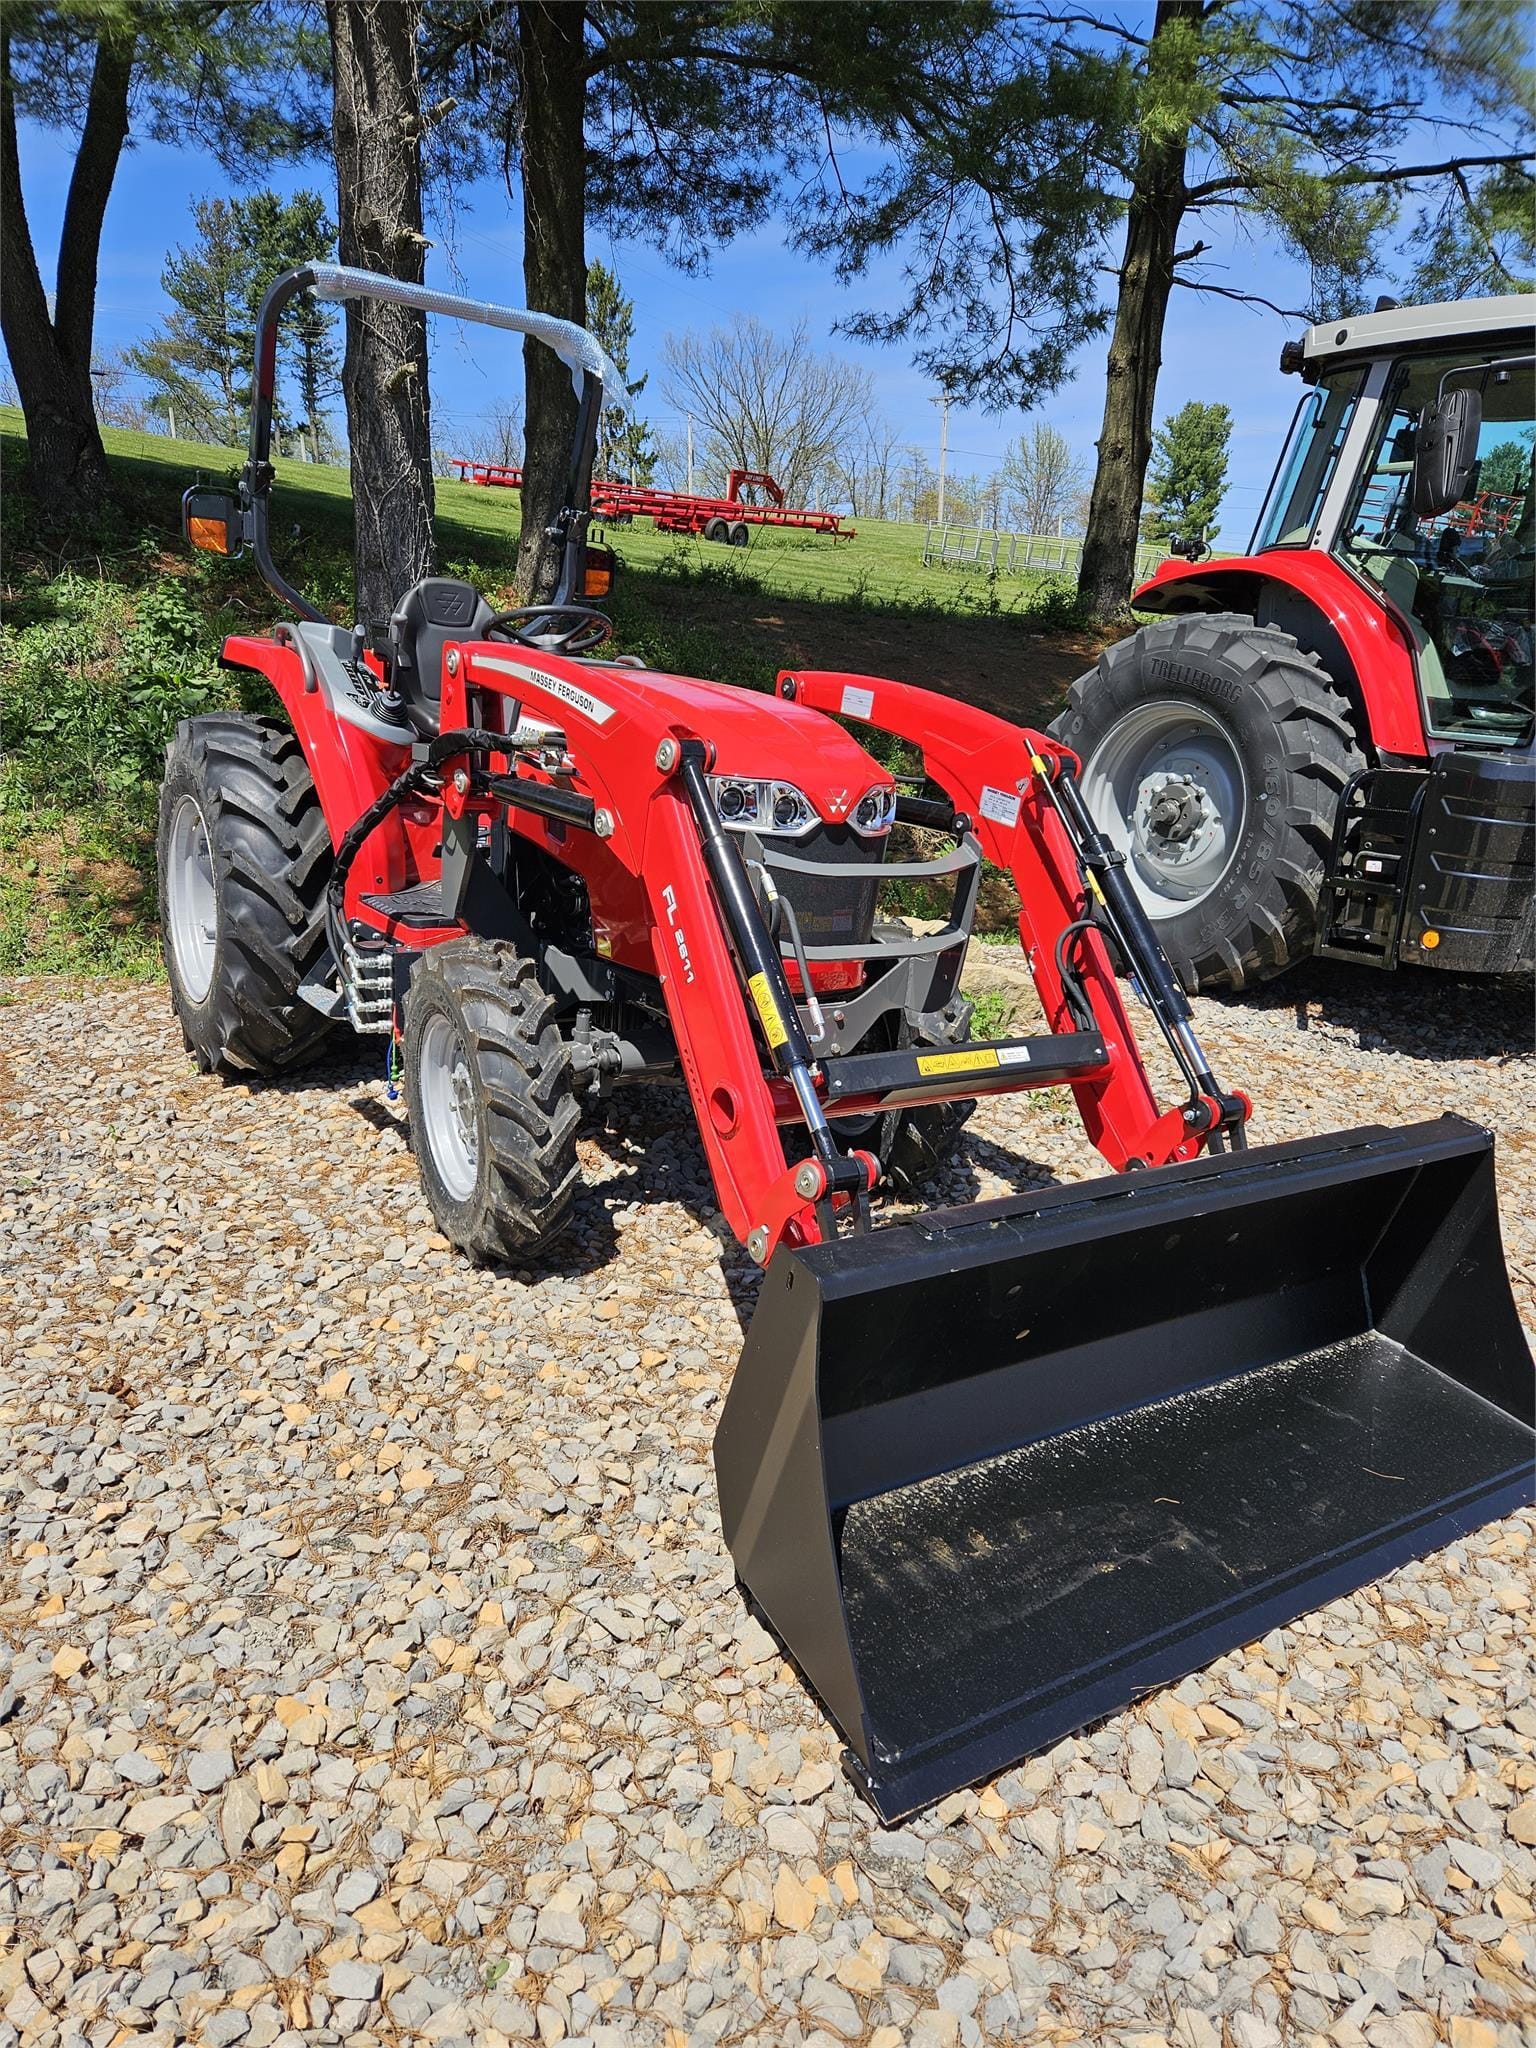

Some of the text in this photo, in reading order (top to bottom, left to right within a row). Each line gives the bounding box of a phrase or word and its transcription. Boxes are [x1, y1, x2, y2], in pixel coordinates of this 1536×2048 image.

[530, 670, 595, 713] MASSEY FERGUSON
[1151, 657, 1242, 704] TRELLEBORG
[662, 884, 678, 927] FL
